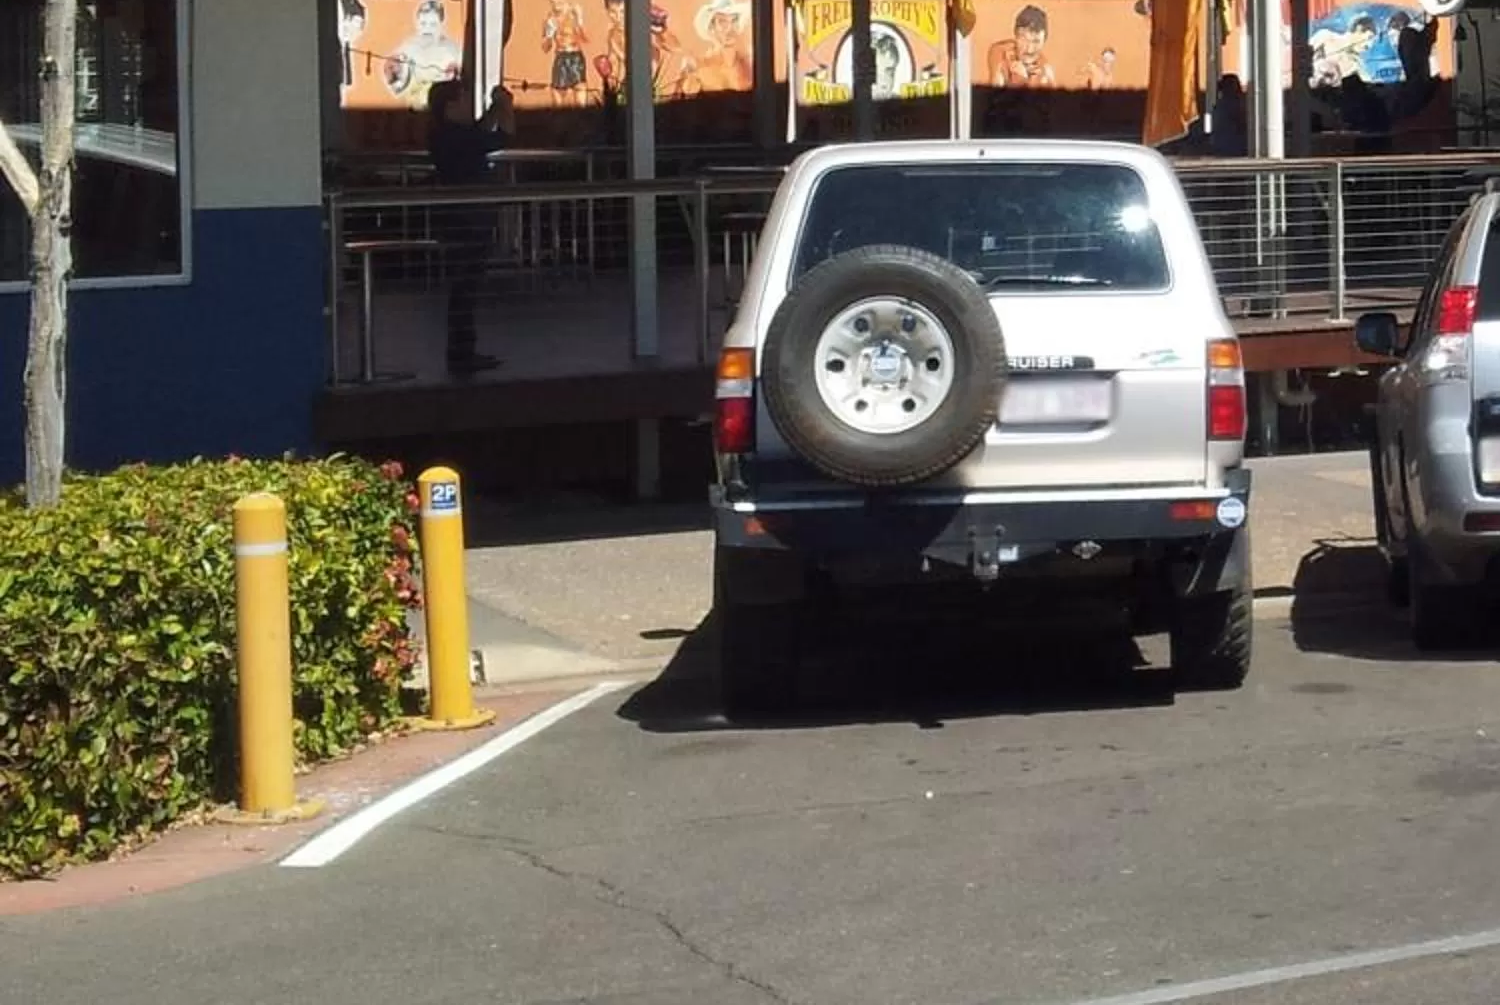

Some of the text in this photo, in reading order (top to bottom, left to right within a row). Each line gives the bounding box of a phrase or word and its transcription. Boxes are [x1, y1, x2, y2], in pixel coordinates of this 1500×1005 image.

[811, 0, 938, 38] FRE ROPHY'S
[1007, 355, 1074, 369] RUISER
[432, 484, 457, 502] 2P
